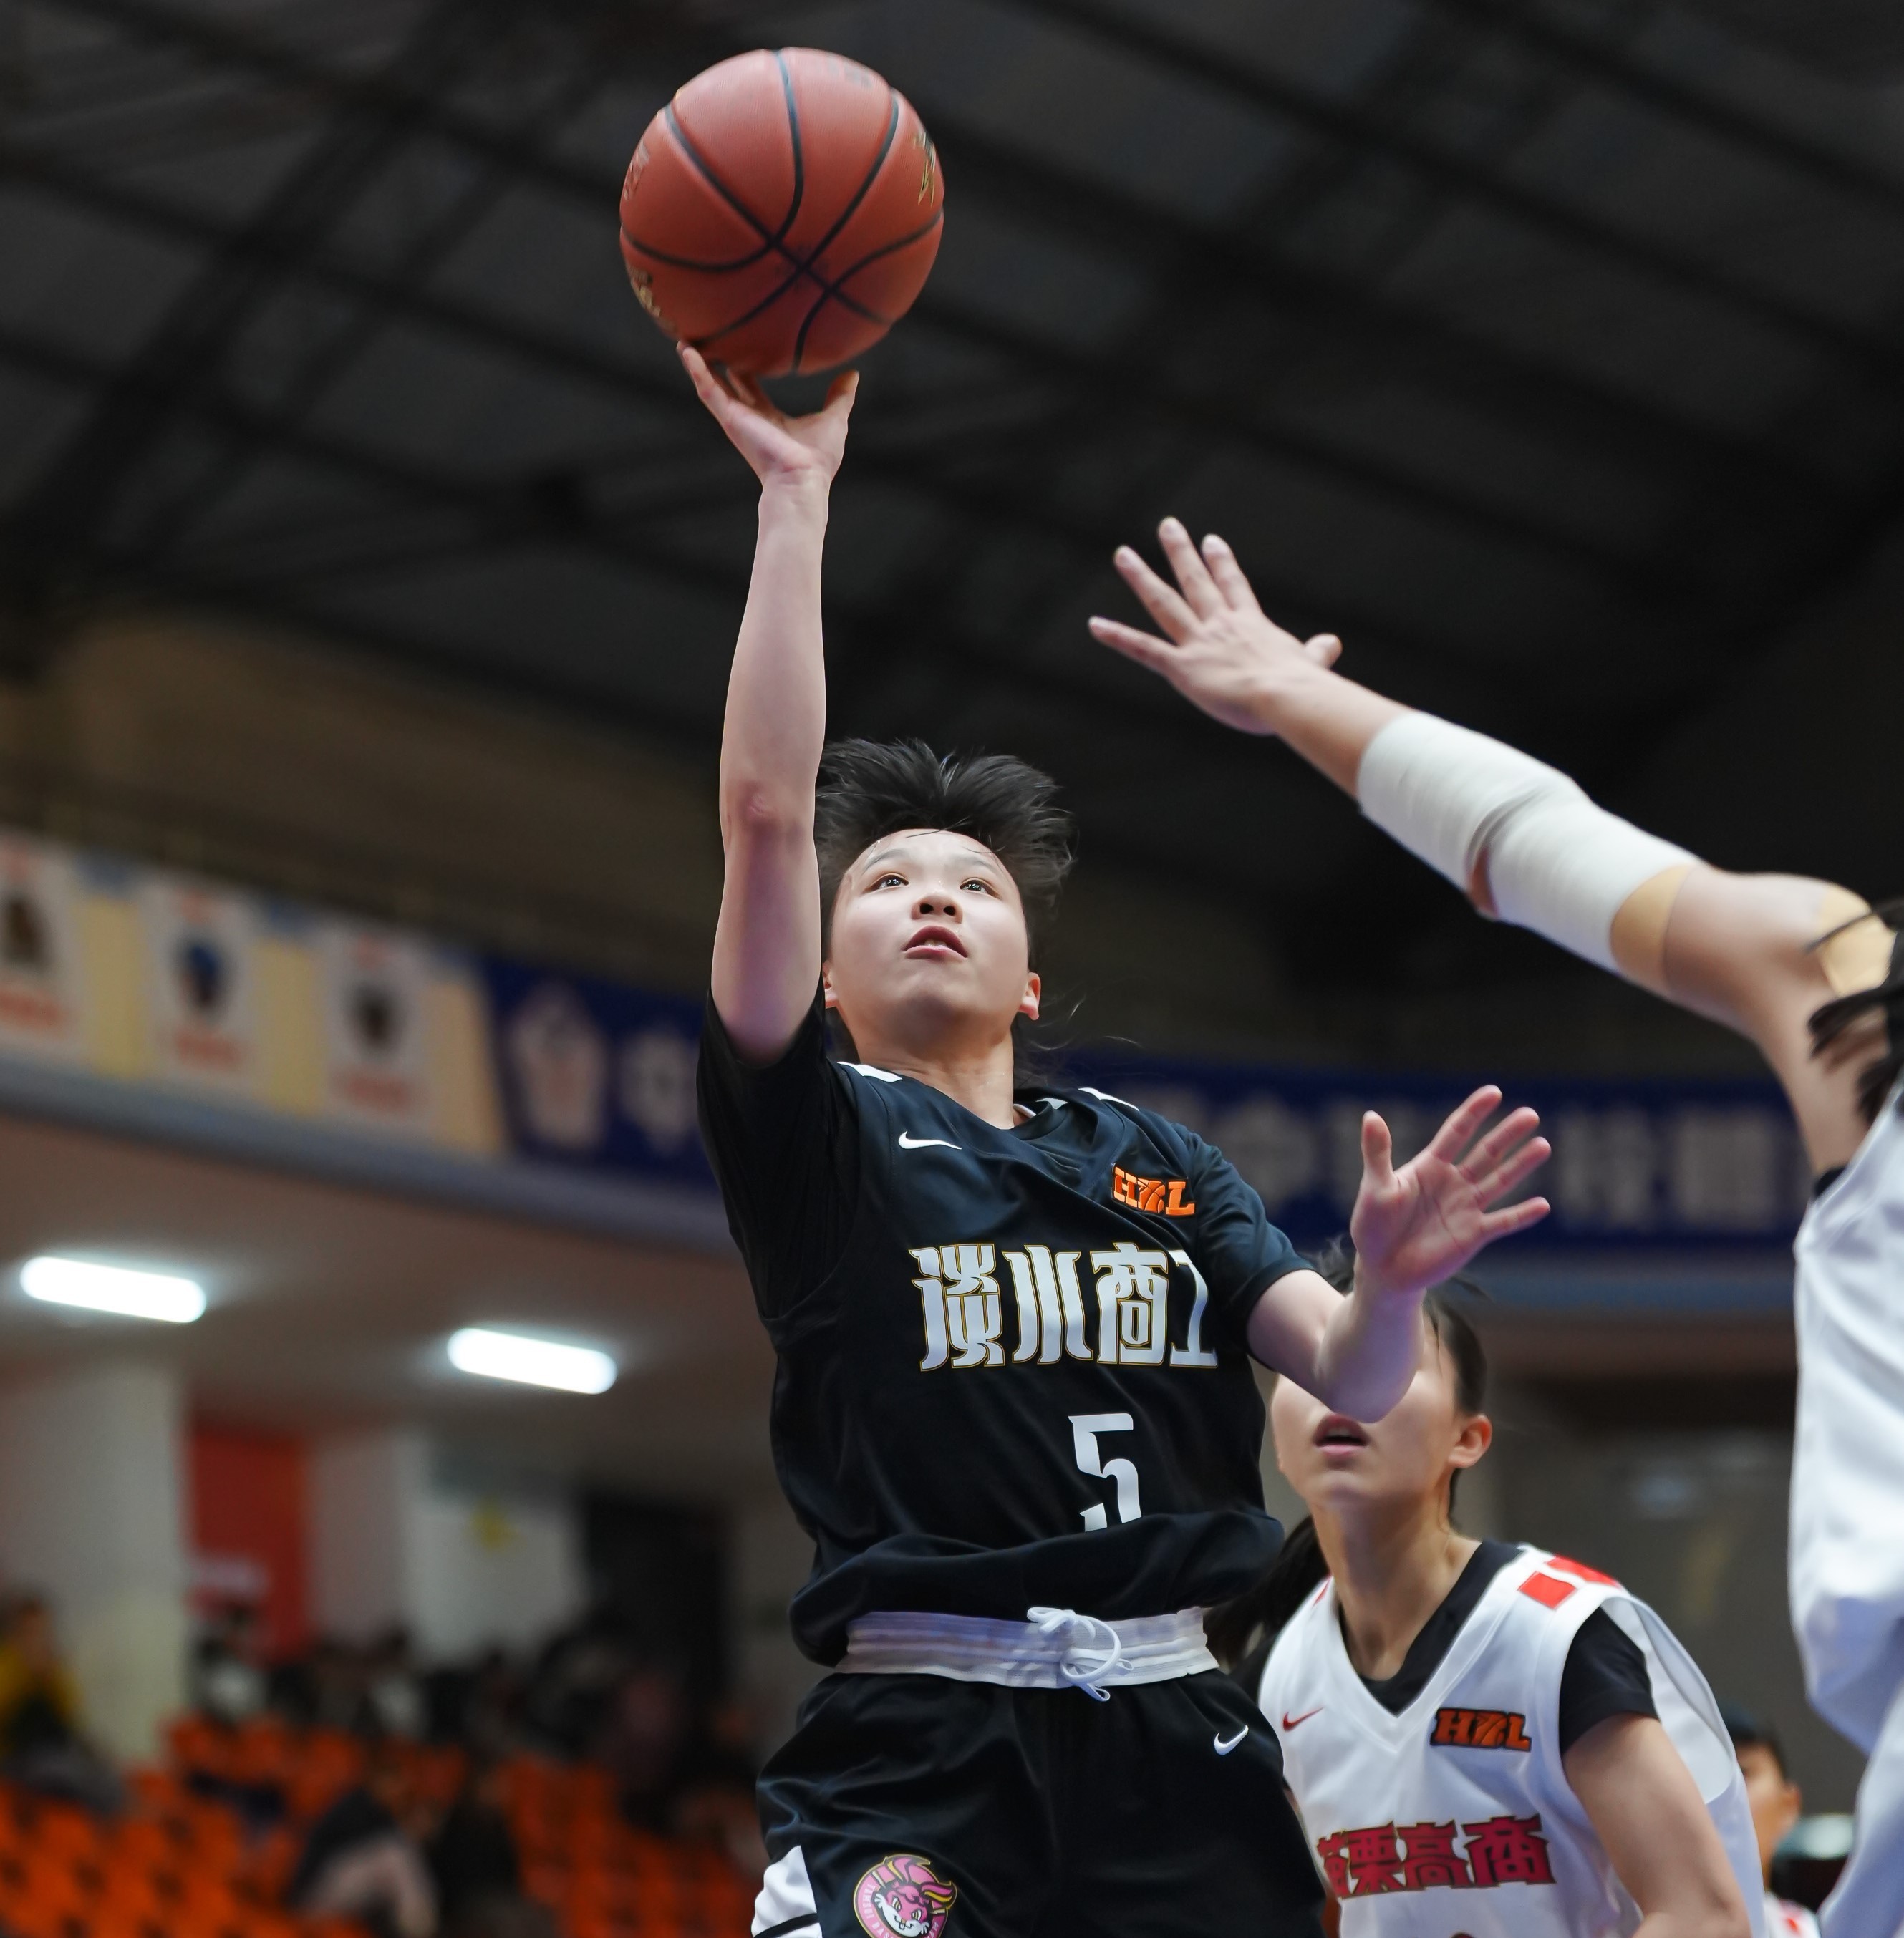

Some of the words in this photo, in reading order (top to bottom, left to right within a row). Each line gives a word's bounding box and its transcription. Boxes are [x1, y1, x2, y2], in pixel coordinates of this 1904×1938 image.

[908, 1242, 1217, 1372] 淡水商工
[1068, 1413, 1141, 1532] 5
